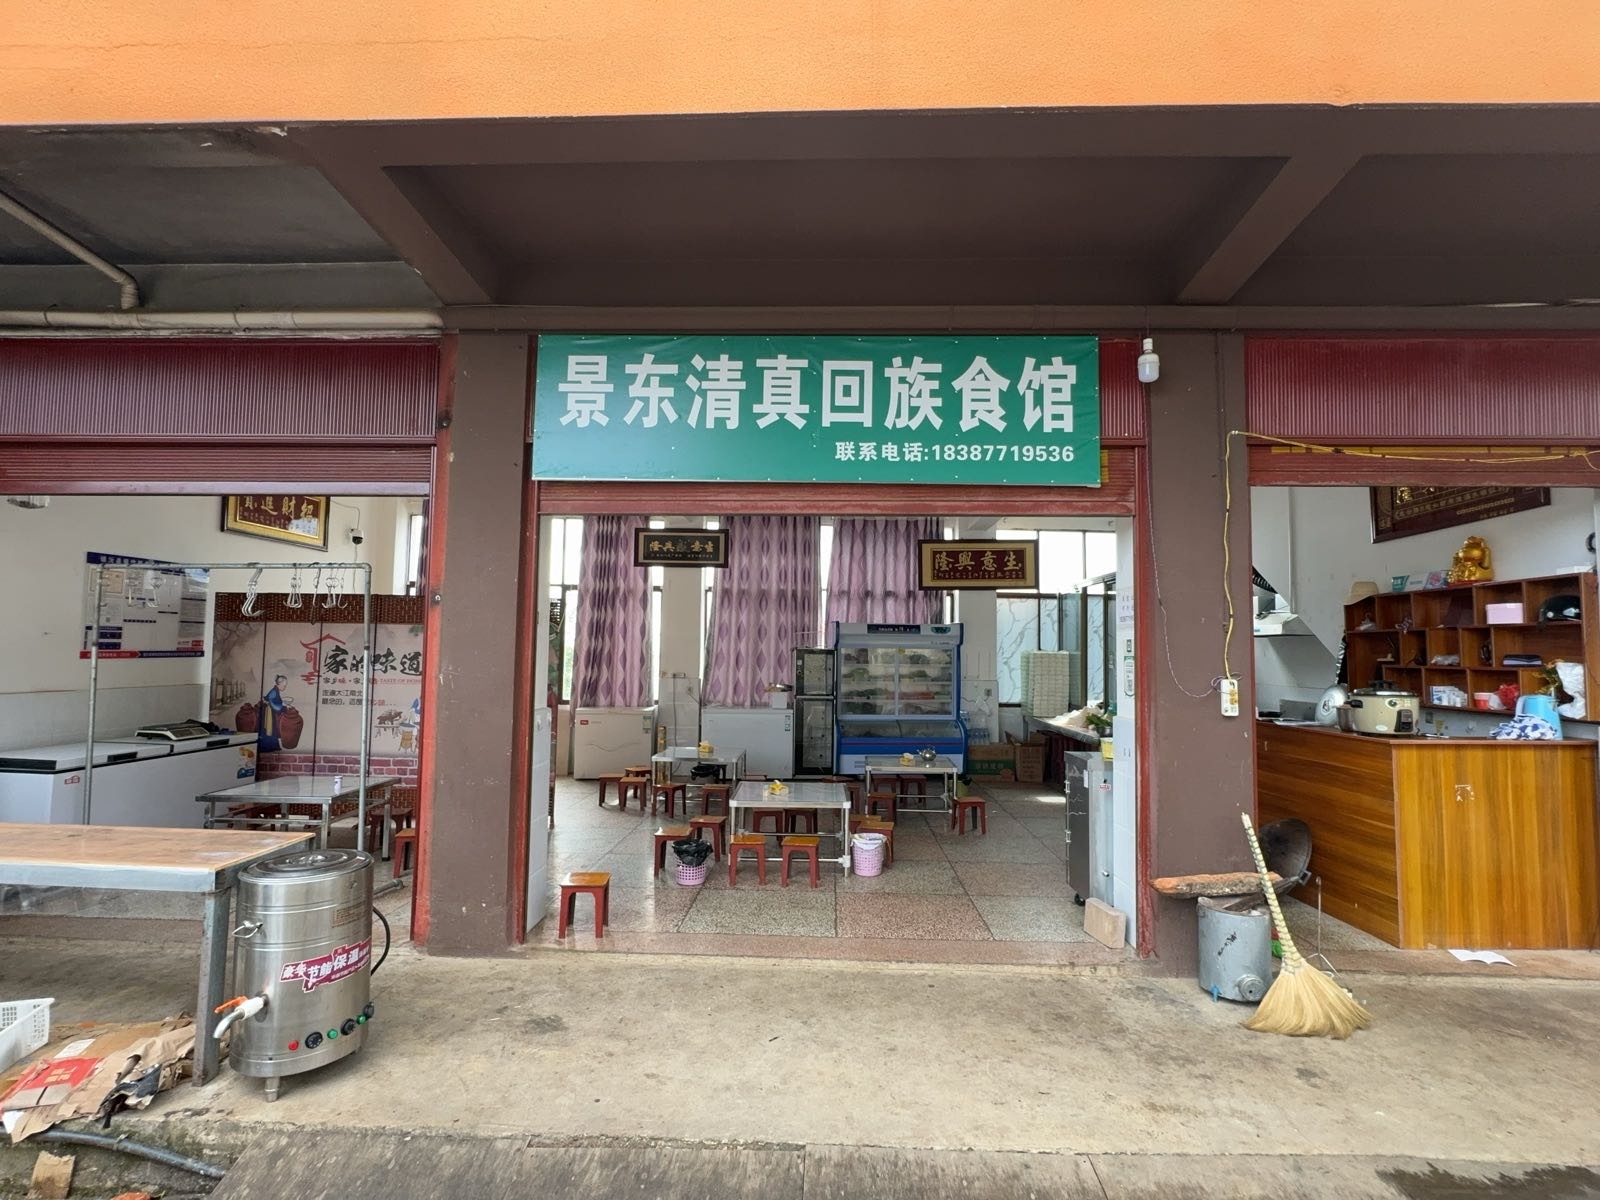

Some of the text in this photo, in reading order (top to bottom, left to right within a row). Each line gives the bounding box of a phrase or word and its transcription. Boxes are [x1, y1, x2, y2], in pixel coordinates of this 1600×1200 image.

[558, 353, 1077, 433] 景东清真回族食馆
